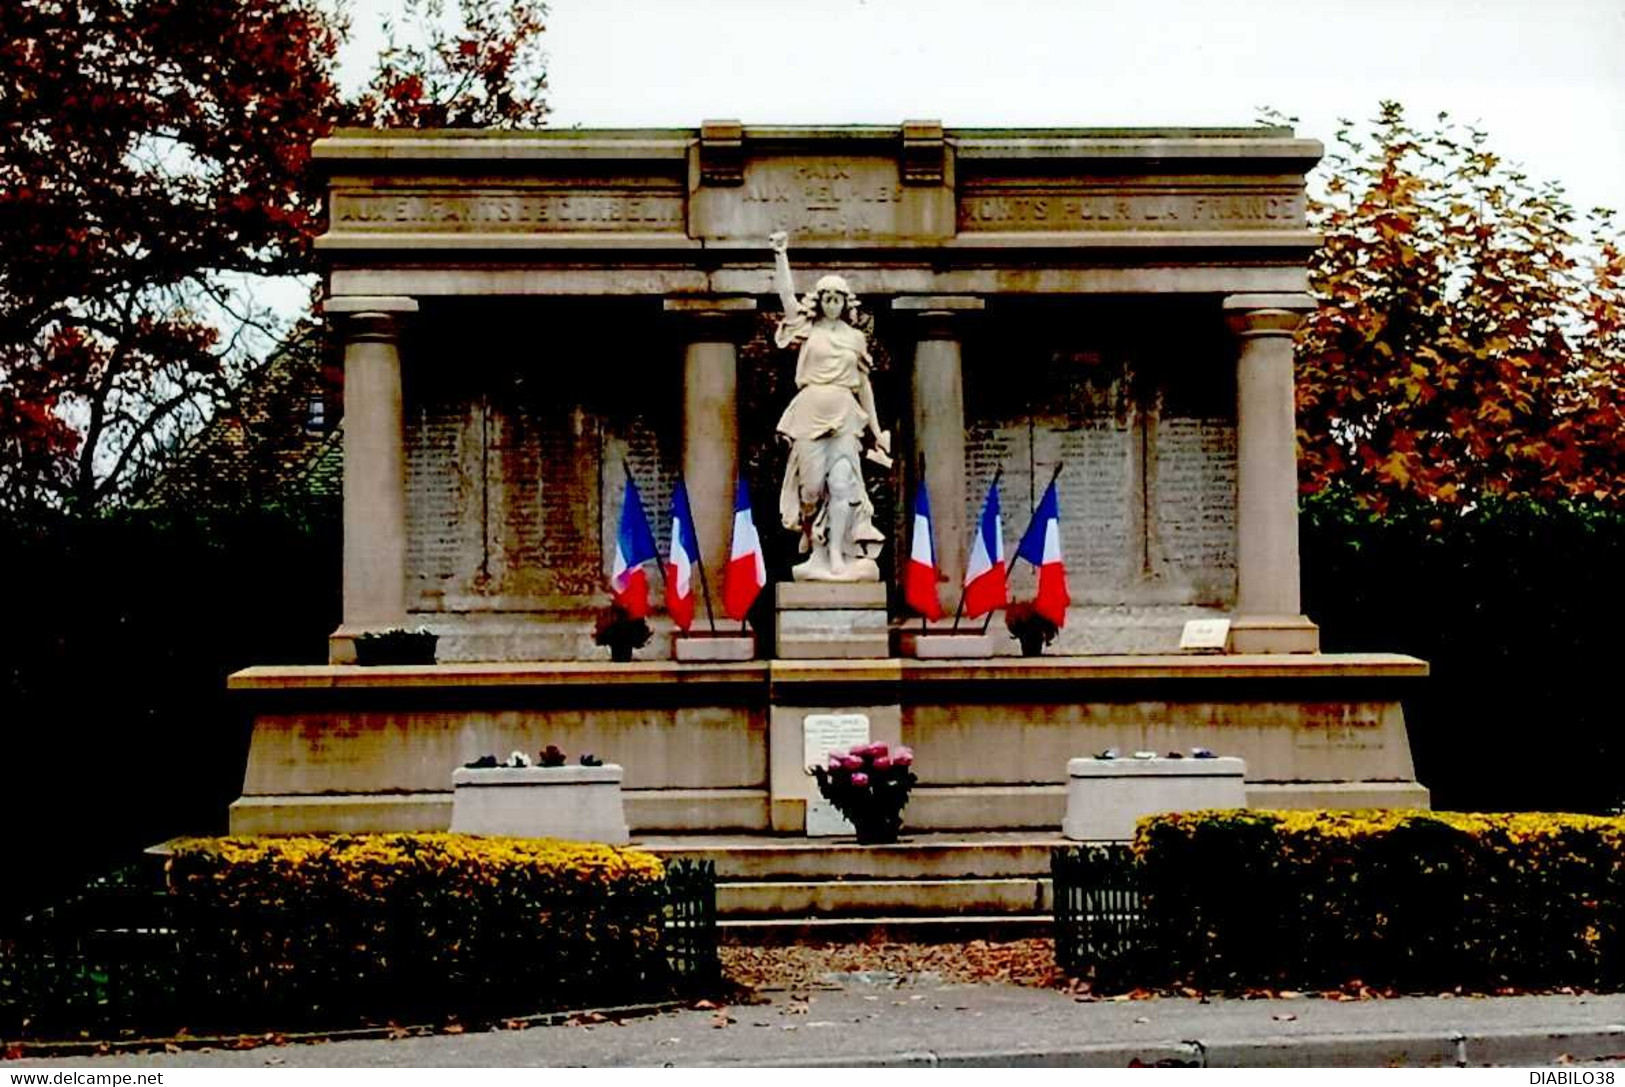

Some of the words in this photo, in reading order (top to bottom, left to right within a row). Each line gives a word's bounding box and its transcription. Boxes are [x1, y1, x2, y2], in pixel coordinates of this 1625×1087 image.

[340, 199, 387, 222] AUX
[1062, 198, 1132, 221] POUR
[1145, 198, 1179, 221] LA
[1193, 197, 1296, 220] FRANCE
